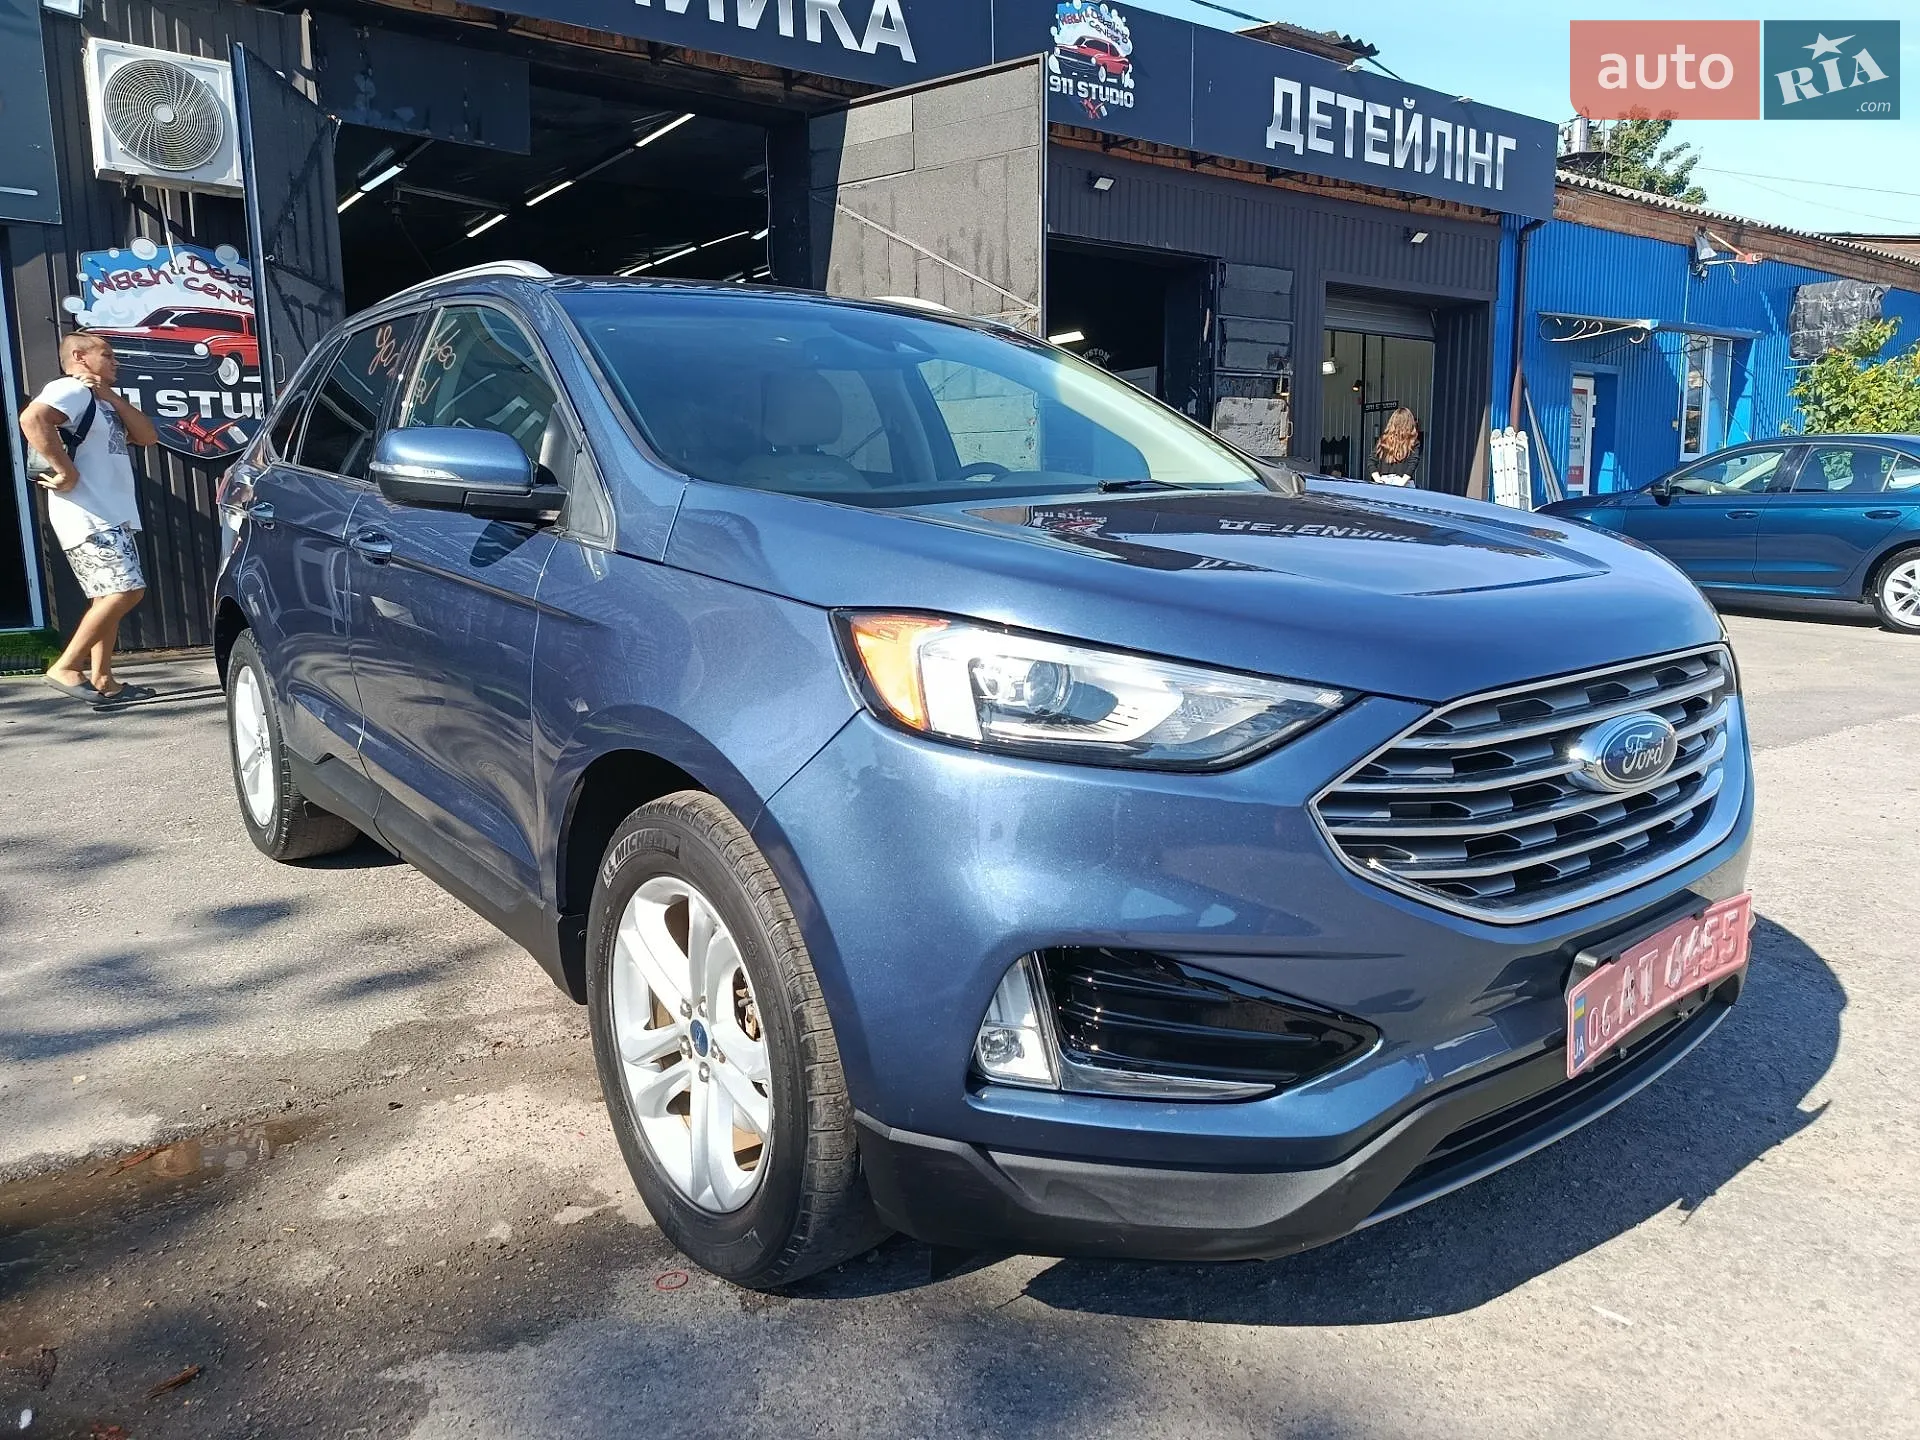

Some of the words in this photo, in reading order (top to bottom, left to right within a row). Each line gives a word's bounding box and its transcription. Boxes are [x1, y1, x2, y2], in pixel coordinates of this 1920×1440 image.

[1049, 75, 1073, 96] 911
[1077, 81, 1134, 108] STUDIO
[1266, 77, 1517, 191] ДЕТЕЙЛІНГ
[90, 265, 174, 295] Wash
[1622, 731, 1665, 775] Ford
[1619, 948, 1659, 1024] AT
